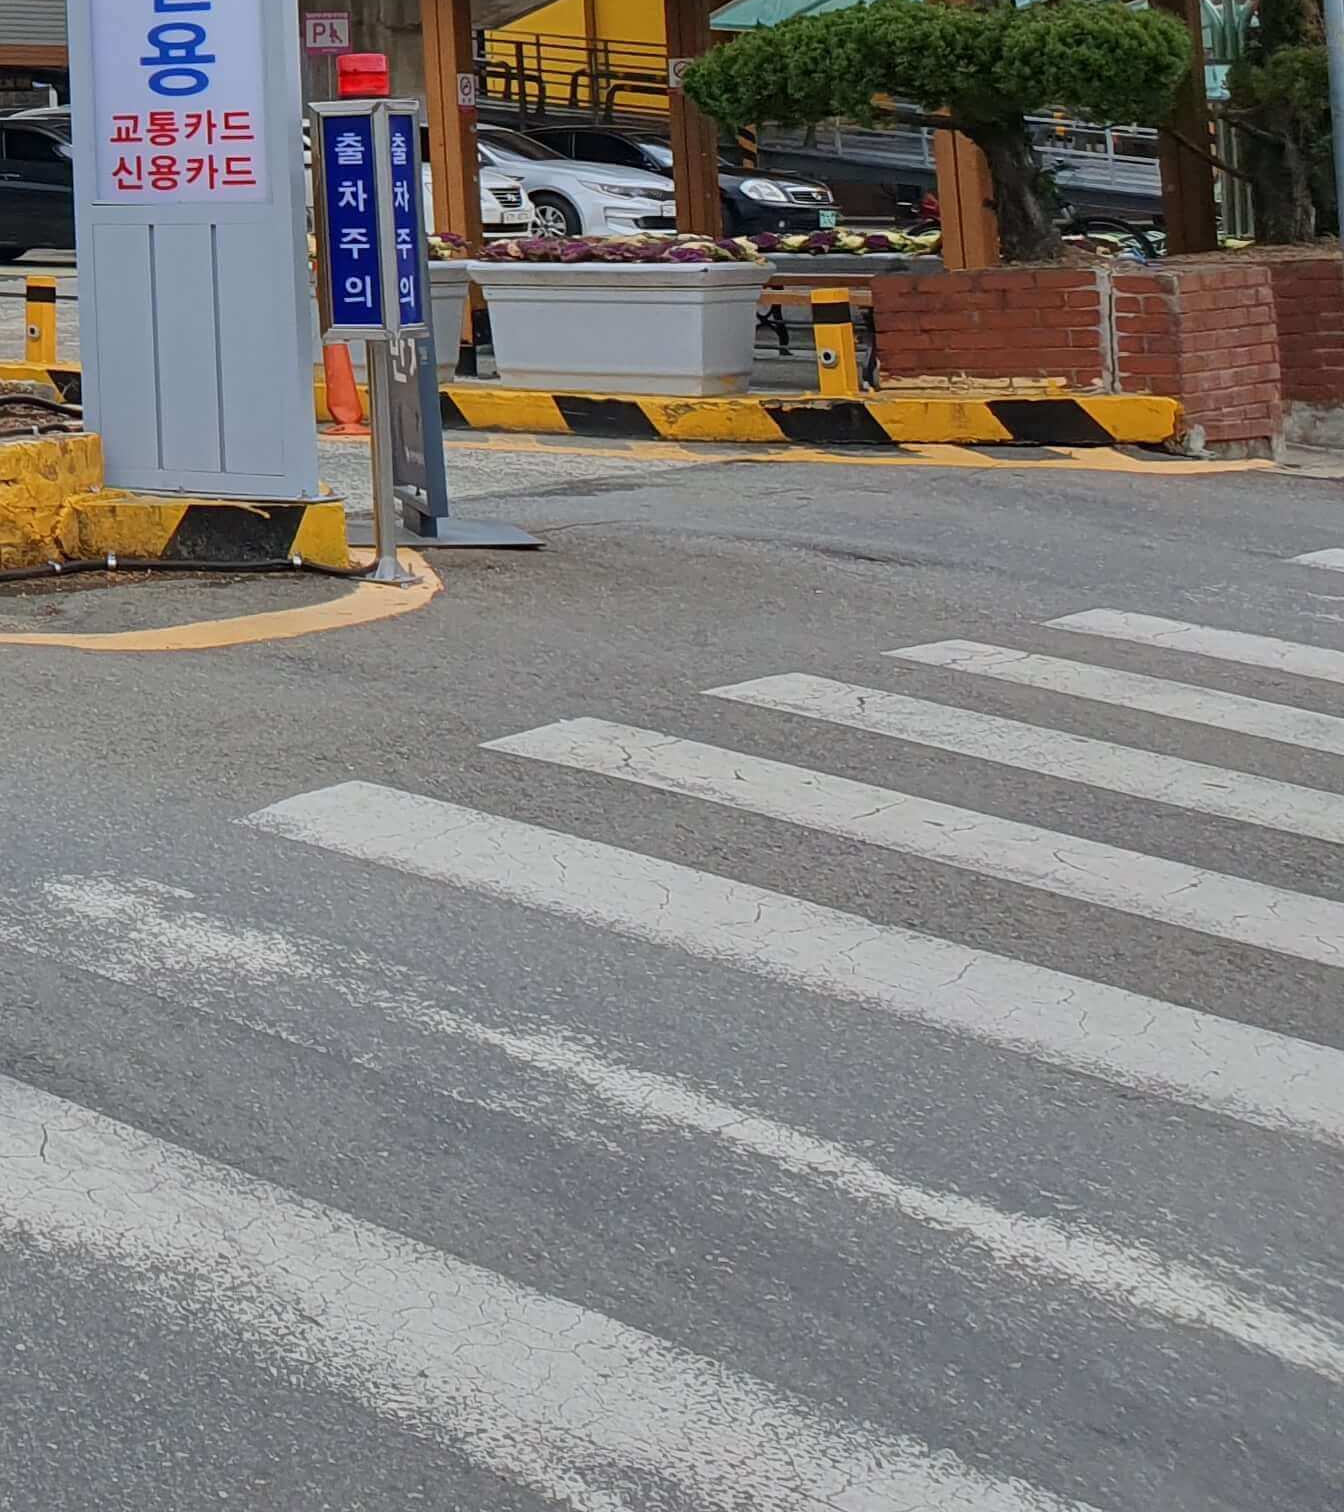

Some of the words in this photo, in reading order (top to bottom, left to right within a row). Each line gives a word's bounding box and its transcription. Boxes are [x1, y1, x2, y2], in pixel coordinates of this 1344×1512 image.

[313, 22, 326, 44] P
[110, 109, 255, 146] 교통카드
[112, 154, 257, 191] 신용카드
[334, 132, 372, 308] 출차주의
[391, 132, 415, 308] 출차주의
